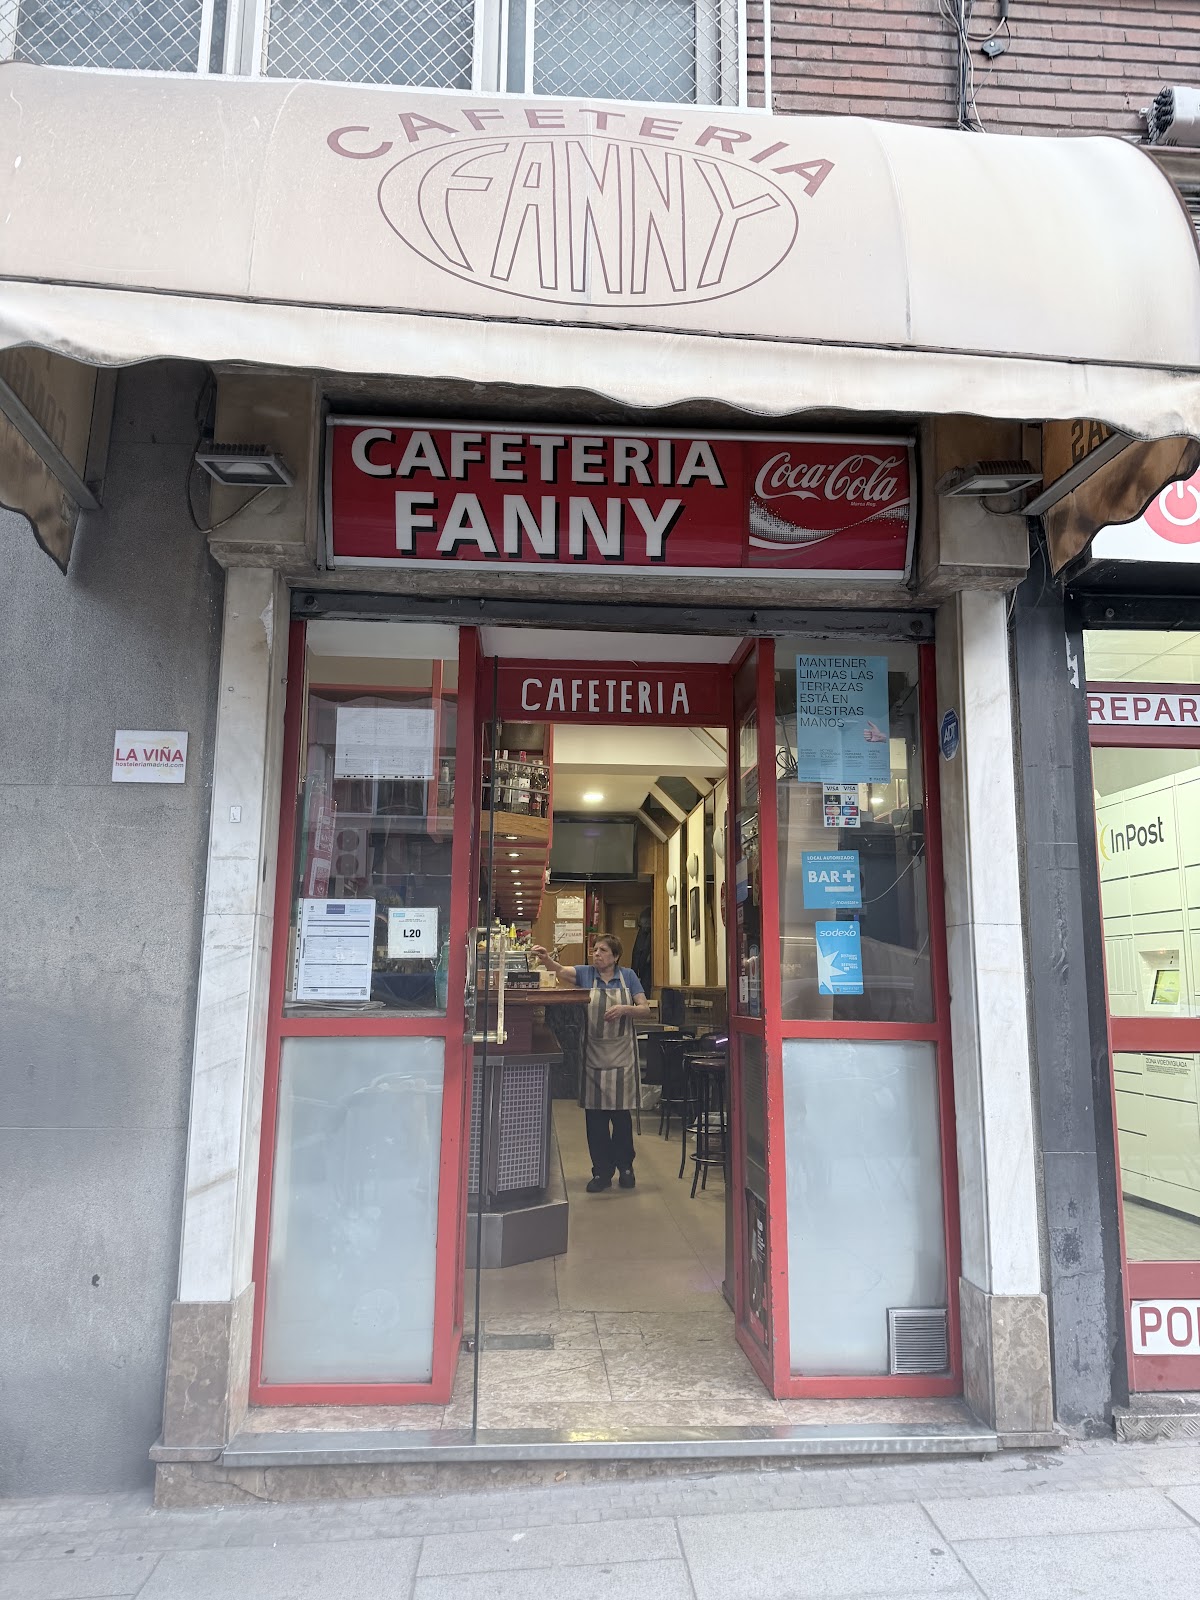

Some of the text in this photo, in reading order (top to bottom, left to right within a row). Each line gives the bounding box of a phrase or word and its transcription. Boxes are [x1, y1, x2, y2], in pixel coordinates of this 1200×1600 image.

[327, 108, 836, 198] CAFETERIA
[417, 140, 780, 294] FANNY
[351, 428, 726, 487] CAFETERIA
[754, 452, 905, 501] Coca-Cola
[394, 490, 685, 561] FANNY
[799, 657, 867, 668] MANTENER
[800, 670, 874, 680] LIMPIAS LAS
[521, 678, 690, 715] CAFETERIA
[800, 681, 864, 692] TERRAZAS
[800, 692, 849, 704] ESTÁ EN
[800, 705, 864, 716] NUESTRAS
[1087, 697, 1198, 722] REPAR
[800, 717, 845, 728] MANOS
[115, 746, 184, 762] LA VIÑA
[1110, 816, 1164, 854] InPost
[403, 929, 421, 938] L20
[819, 928, 857, 937] sodexo
[1139, 1306, 1200, 1348] PO
